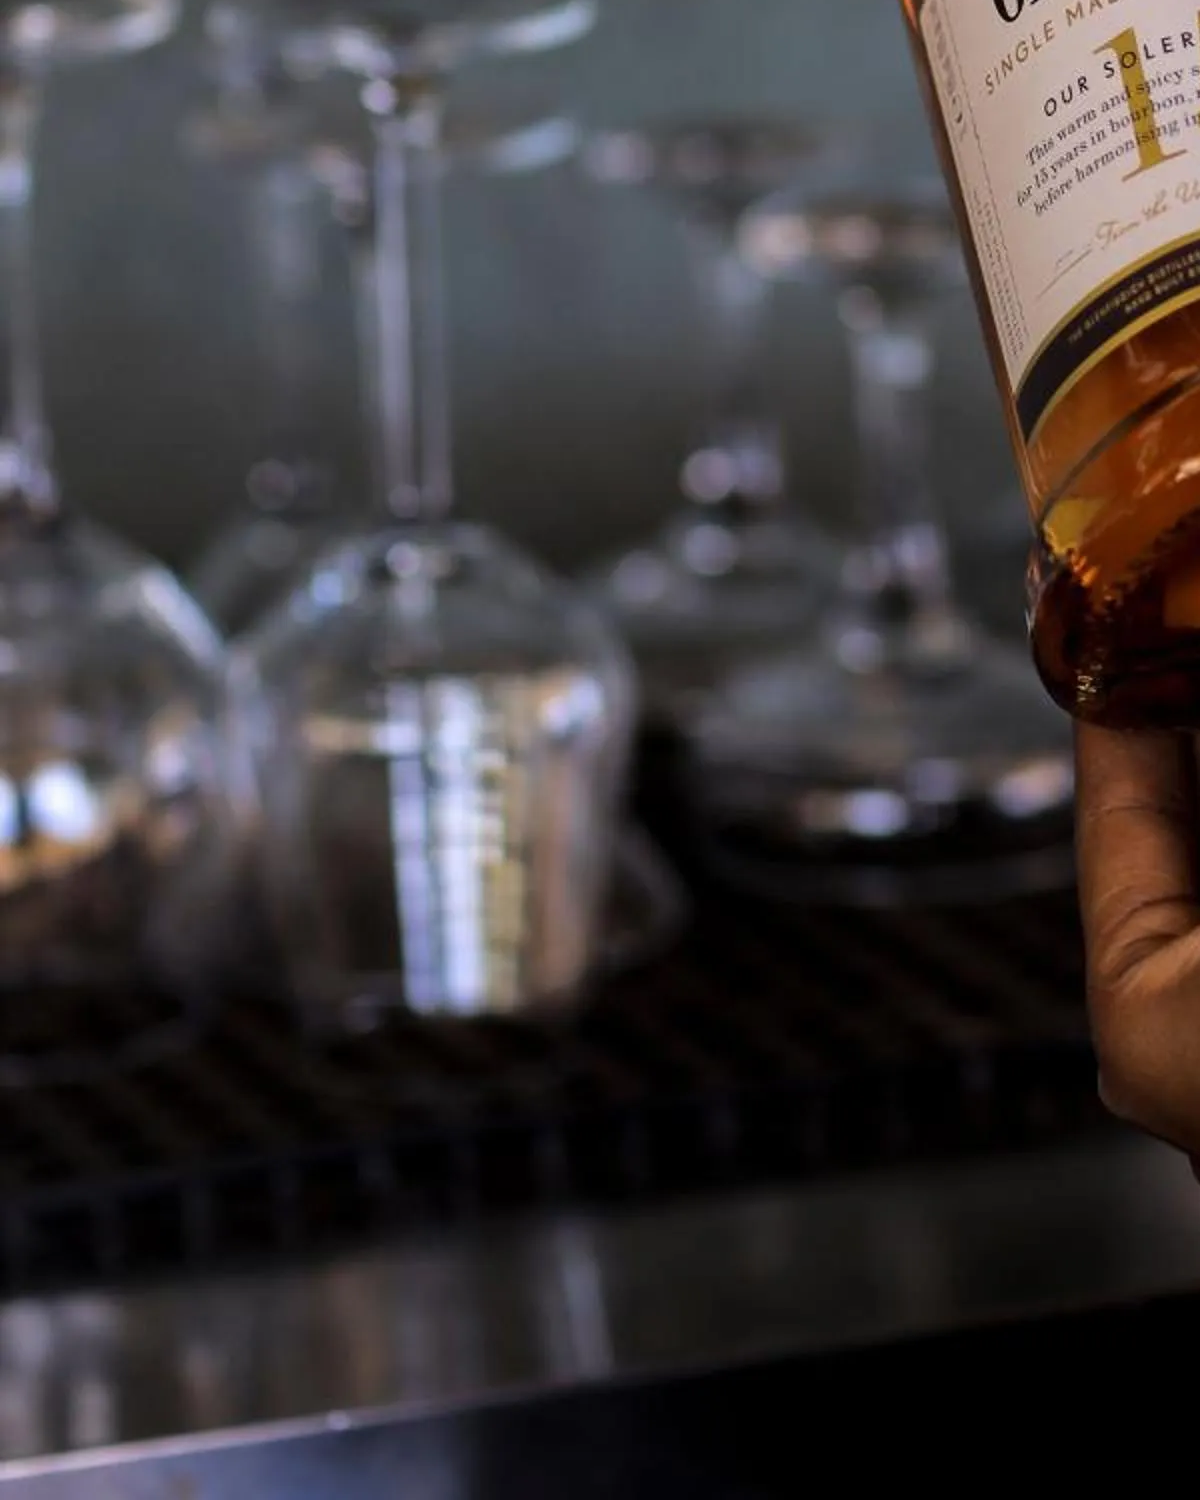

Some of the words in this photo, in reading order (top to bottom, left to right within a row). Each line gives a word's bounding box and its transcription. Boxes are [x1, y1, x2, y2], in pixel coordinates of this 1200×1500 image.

[985, 20, 1055, 94] SINGLE
[1025, 136, 1055, 166] This
[1056, 109, 1098, 141] warm
[1101, 85, 1131, 113] and
[1134, 66, 1185, 94] spicy
[1043, 76, 1090, 117] OUR
[1034, 168, 1050, 189] 15
[1050, 137, 1089, 180] years
[1090, 127, 1107, 146] in
